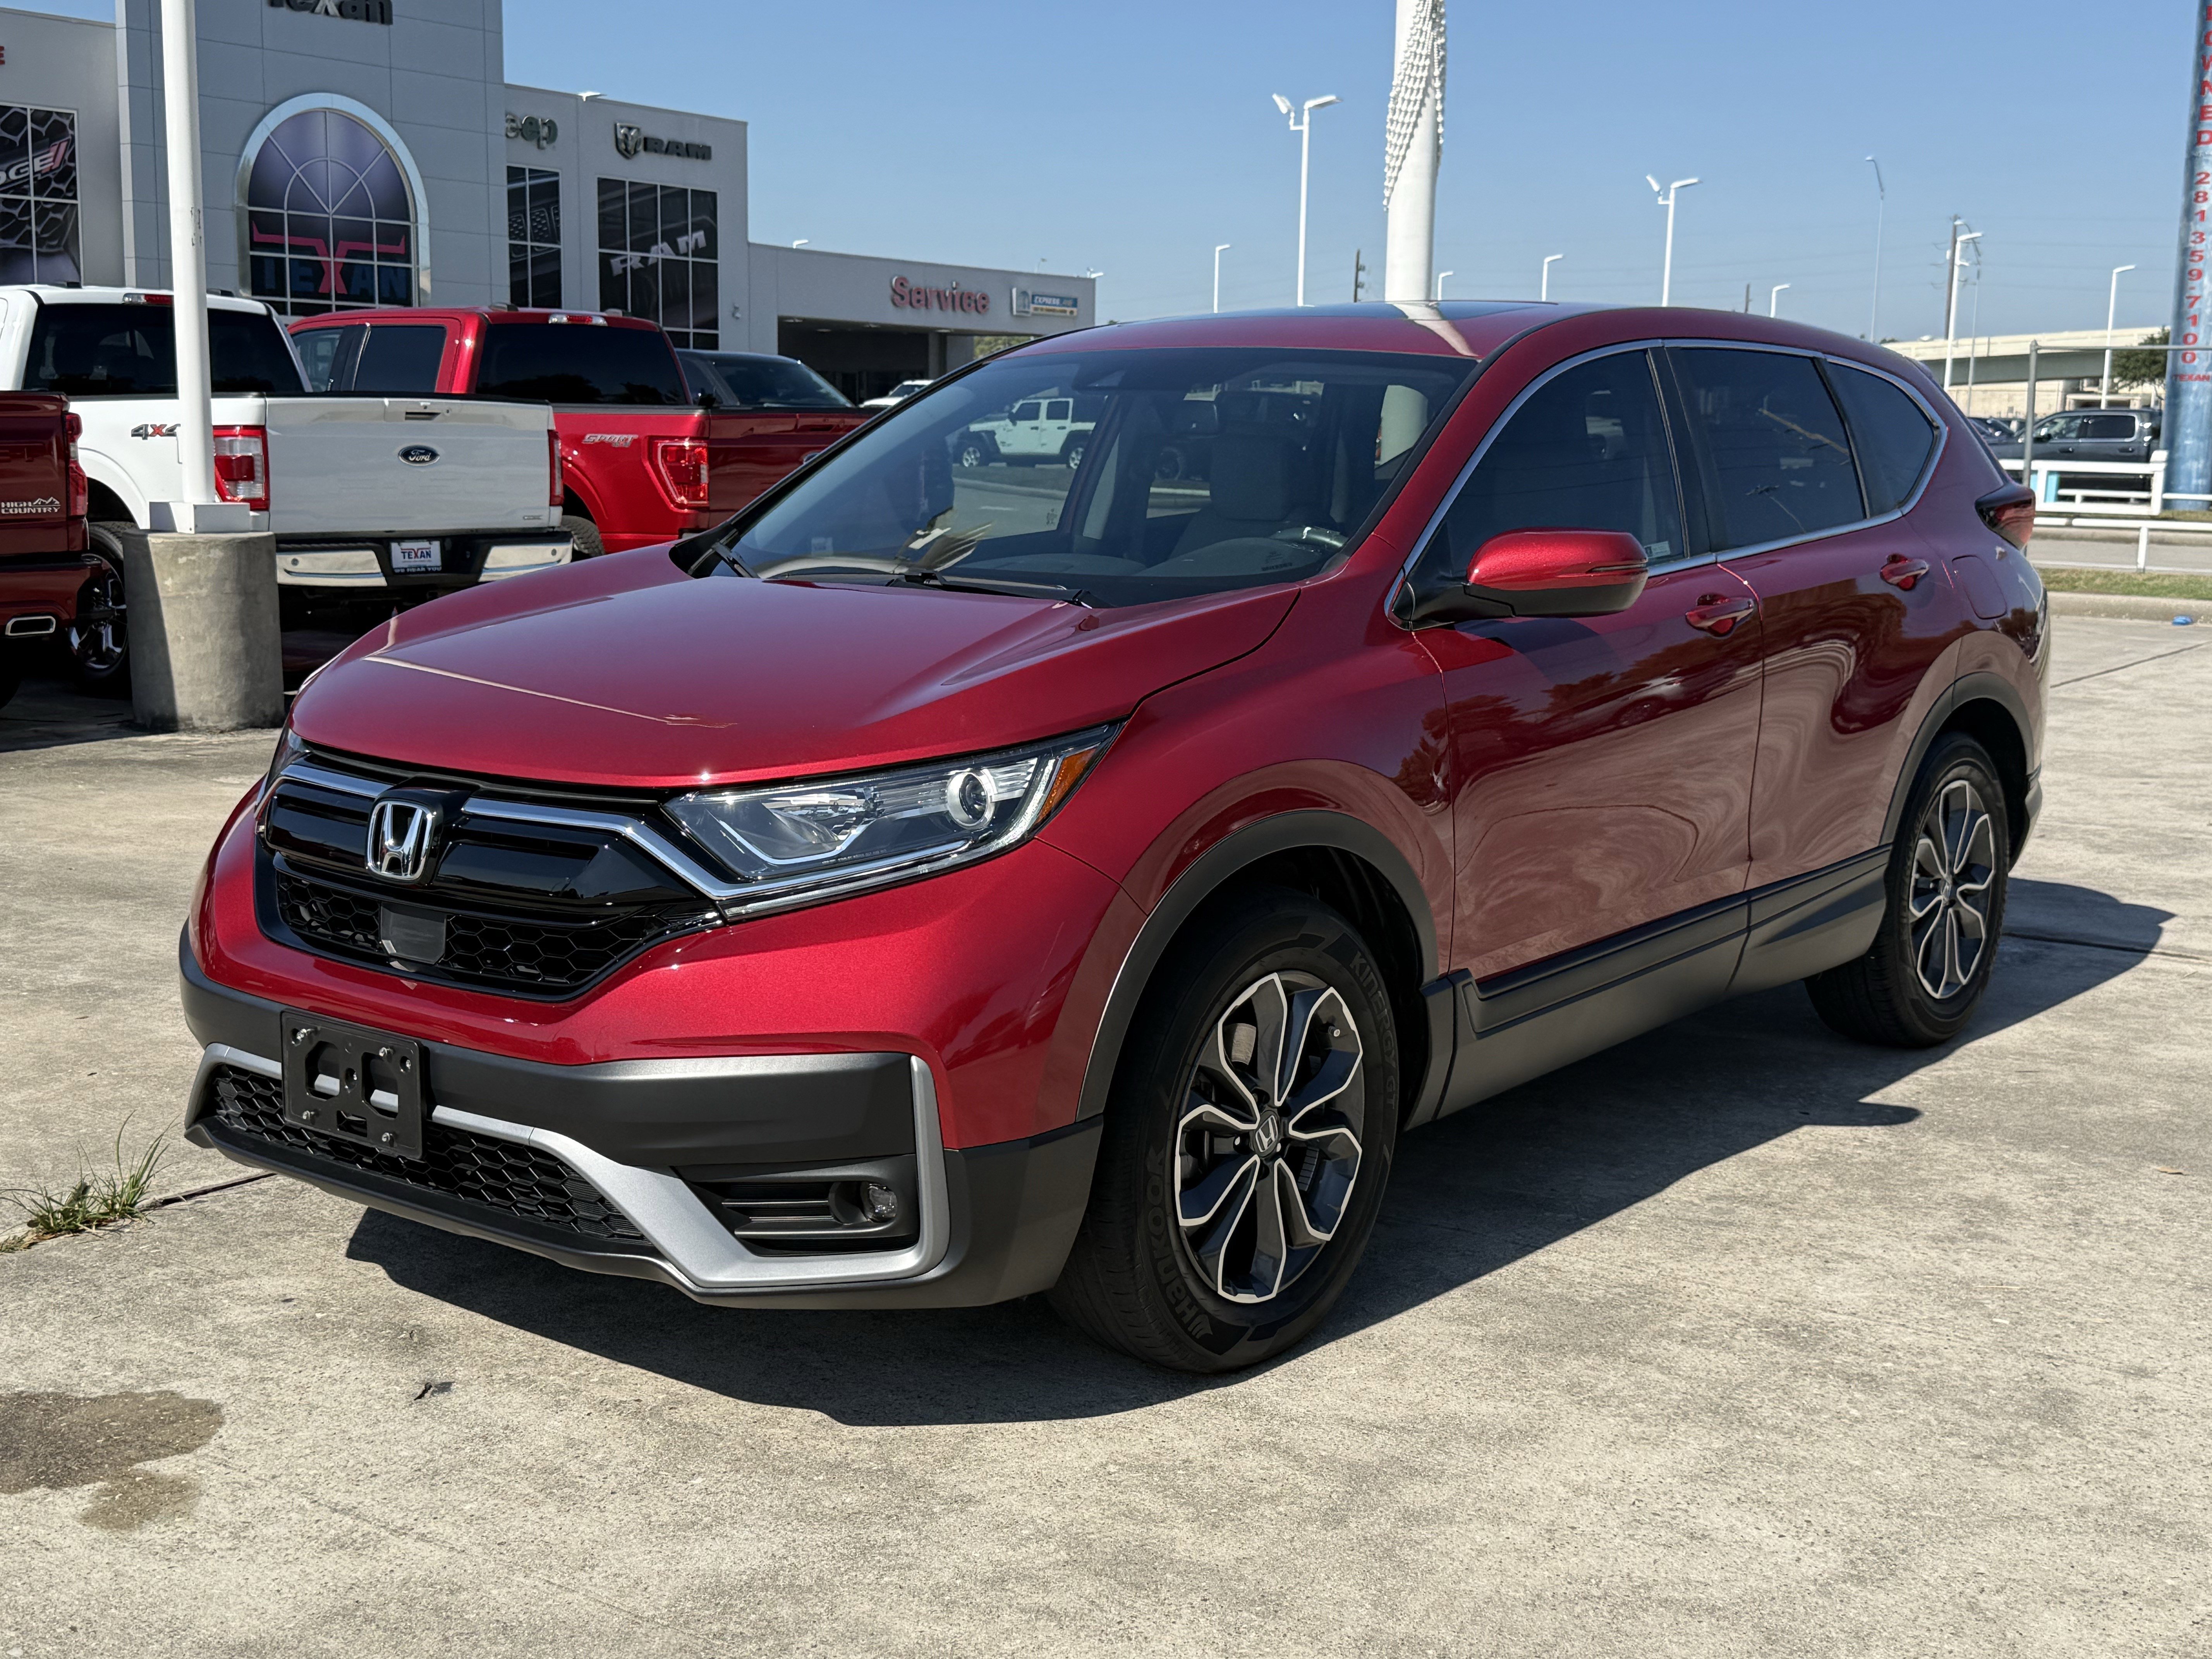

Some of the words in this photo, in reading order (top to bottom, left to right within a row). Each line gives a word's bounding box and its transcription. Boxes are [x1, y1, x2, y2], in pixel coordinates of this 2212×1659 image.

[505, 113, 558, 150] eep
[643, 137, 712, 160] RAM
[2193, 172, 2210, 223] 281
[610, 230, 707, 277] RAM
[891, 276, 990, 314] Service
[2173, 374, 2210, 382] TEXAN
[409, 449, 431, 461] Ford
[400, 547, 431, 560] TEXAN
